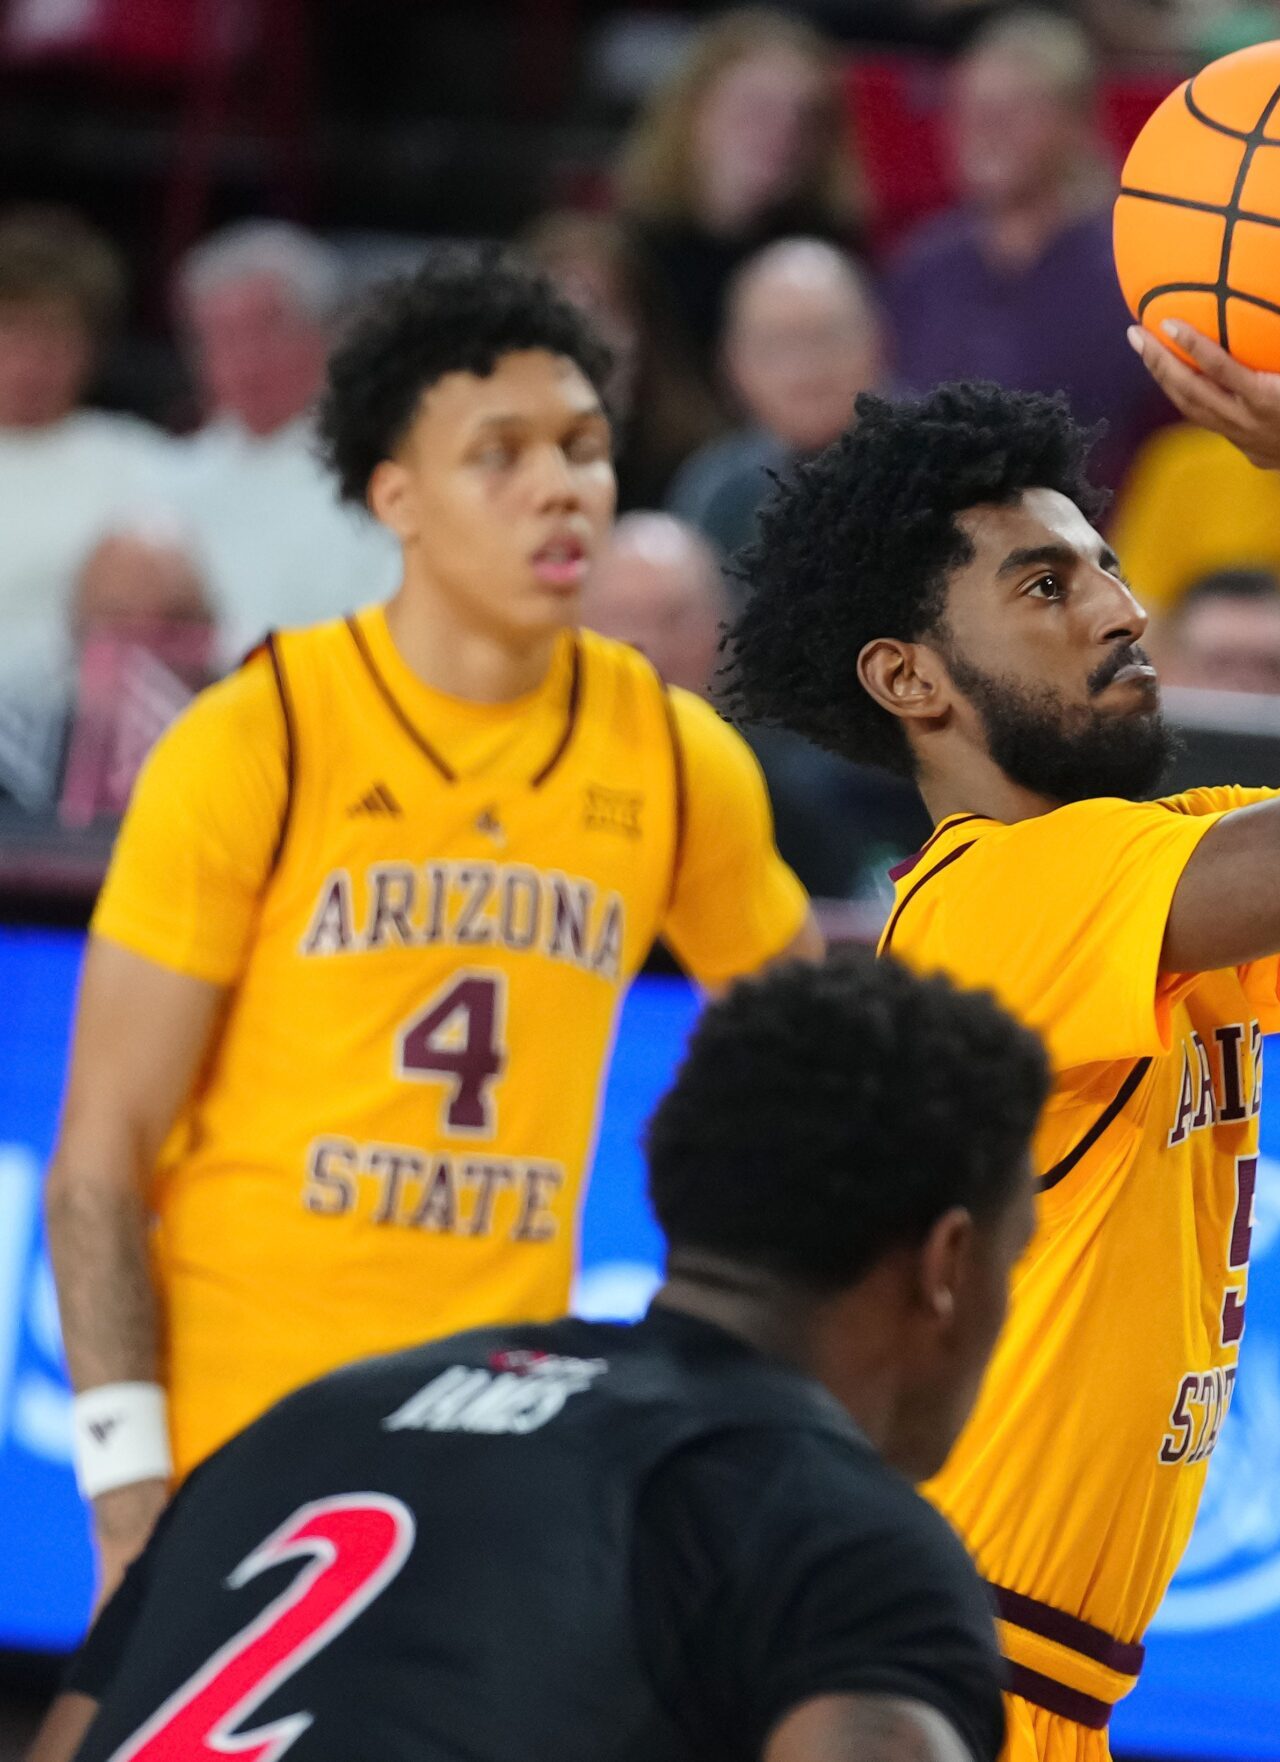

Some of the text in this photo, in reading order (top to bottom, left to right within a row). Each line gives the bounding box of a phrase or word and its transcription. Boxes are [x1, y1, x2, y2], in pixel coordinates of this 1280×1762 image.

[300, 859, 626, 986] ARIZONA
[394, 967, 507, 1138] 4
[304, 1136, 564, 1242] STATE
[103, 1491, 415, 1762] 2
